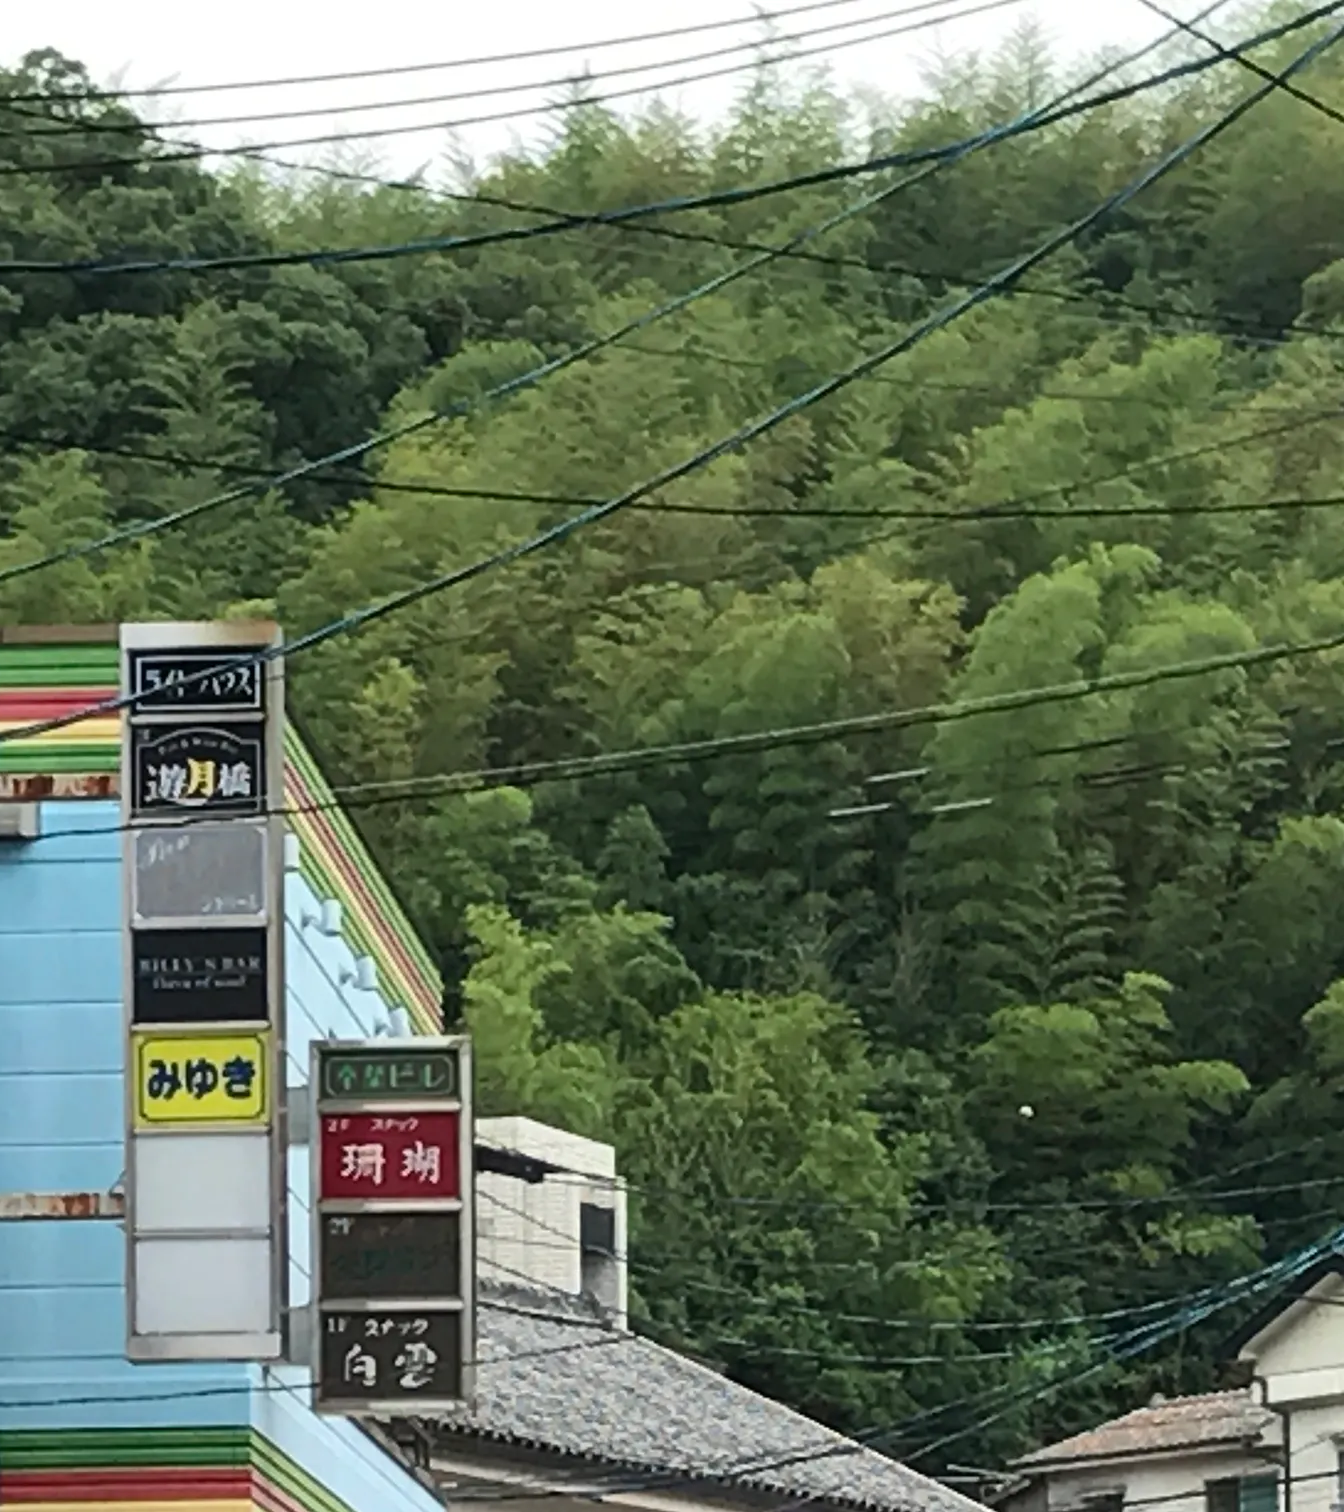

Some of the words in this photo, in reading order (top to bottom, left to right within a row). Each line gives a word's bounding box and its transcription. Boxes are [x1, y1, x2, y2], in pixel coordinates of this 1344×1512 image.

[148, 1055, 256, 1100] みゆき
[370, 1117, 419, 1132] スナック
[340, 1140, 441, 1186] 珊瑚
[365, 1318, 429, 1337] スナック
